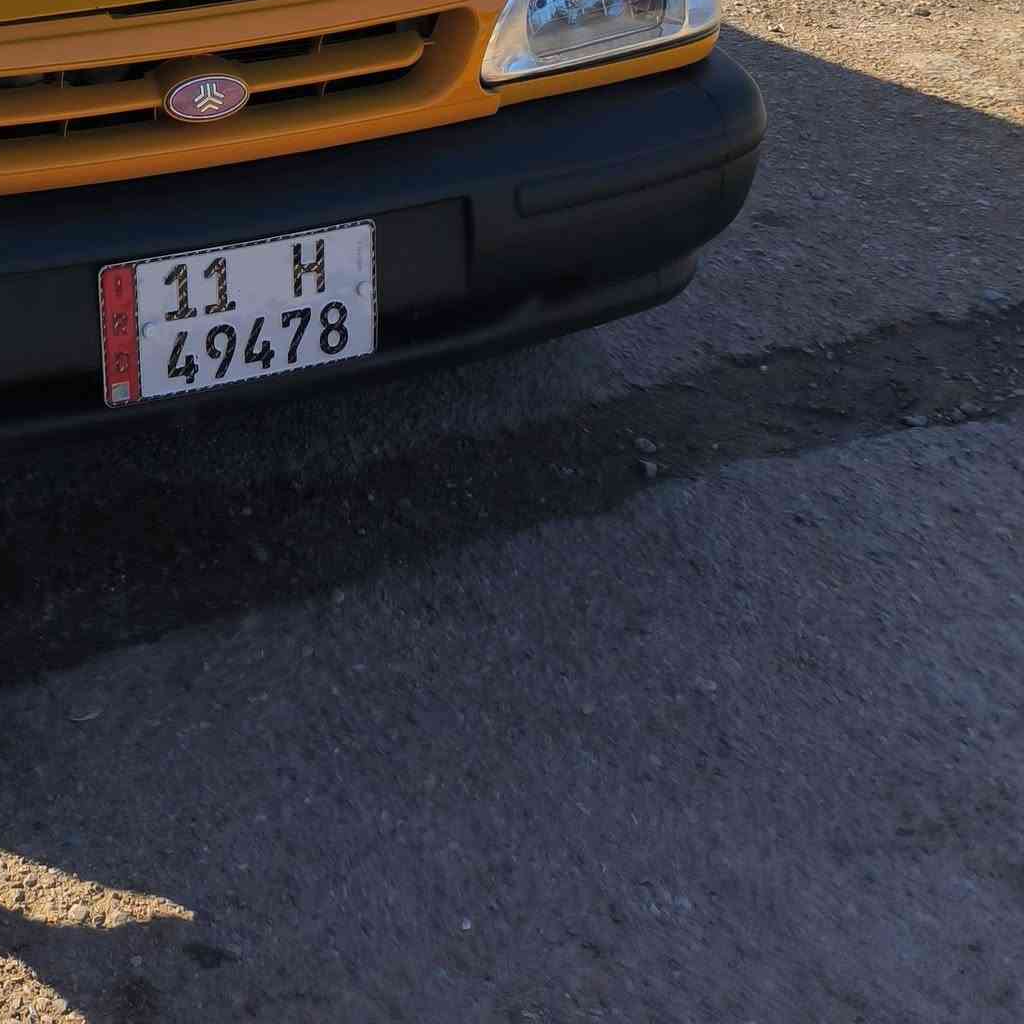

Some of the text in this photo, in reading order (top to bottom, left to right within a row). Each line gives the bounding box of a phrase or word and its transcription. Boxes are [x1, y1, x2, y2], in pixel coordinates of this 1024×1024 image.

[164, 238, 326, 322] 11 H
[167, 301, 349, 385] 49478
